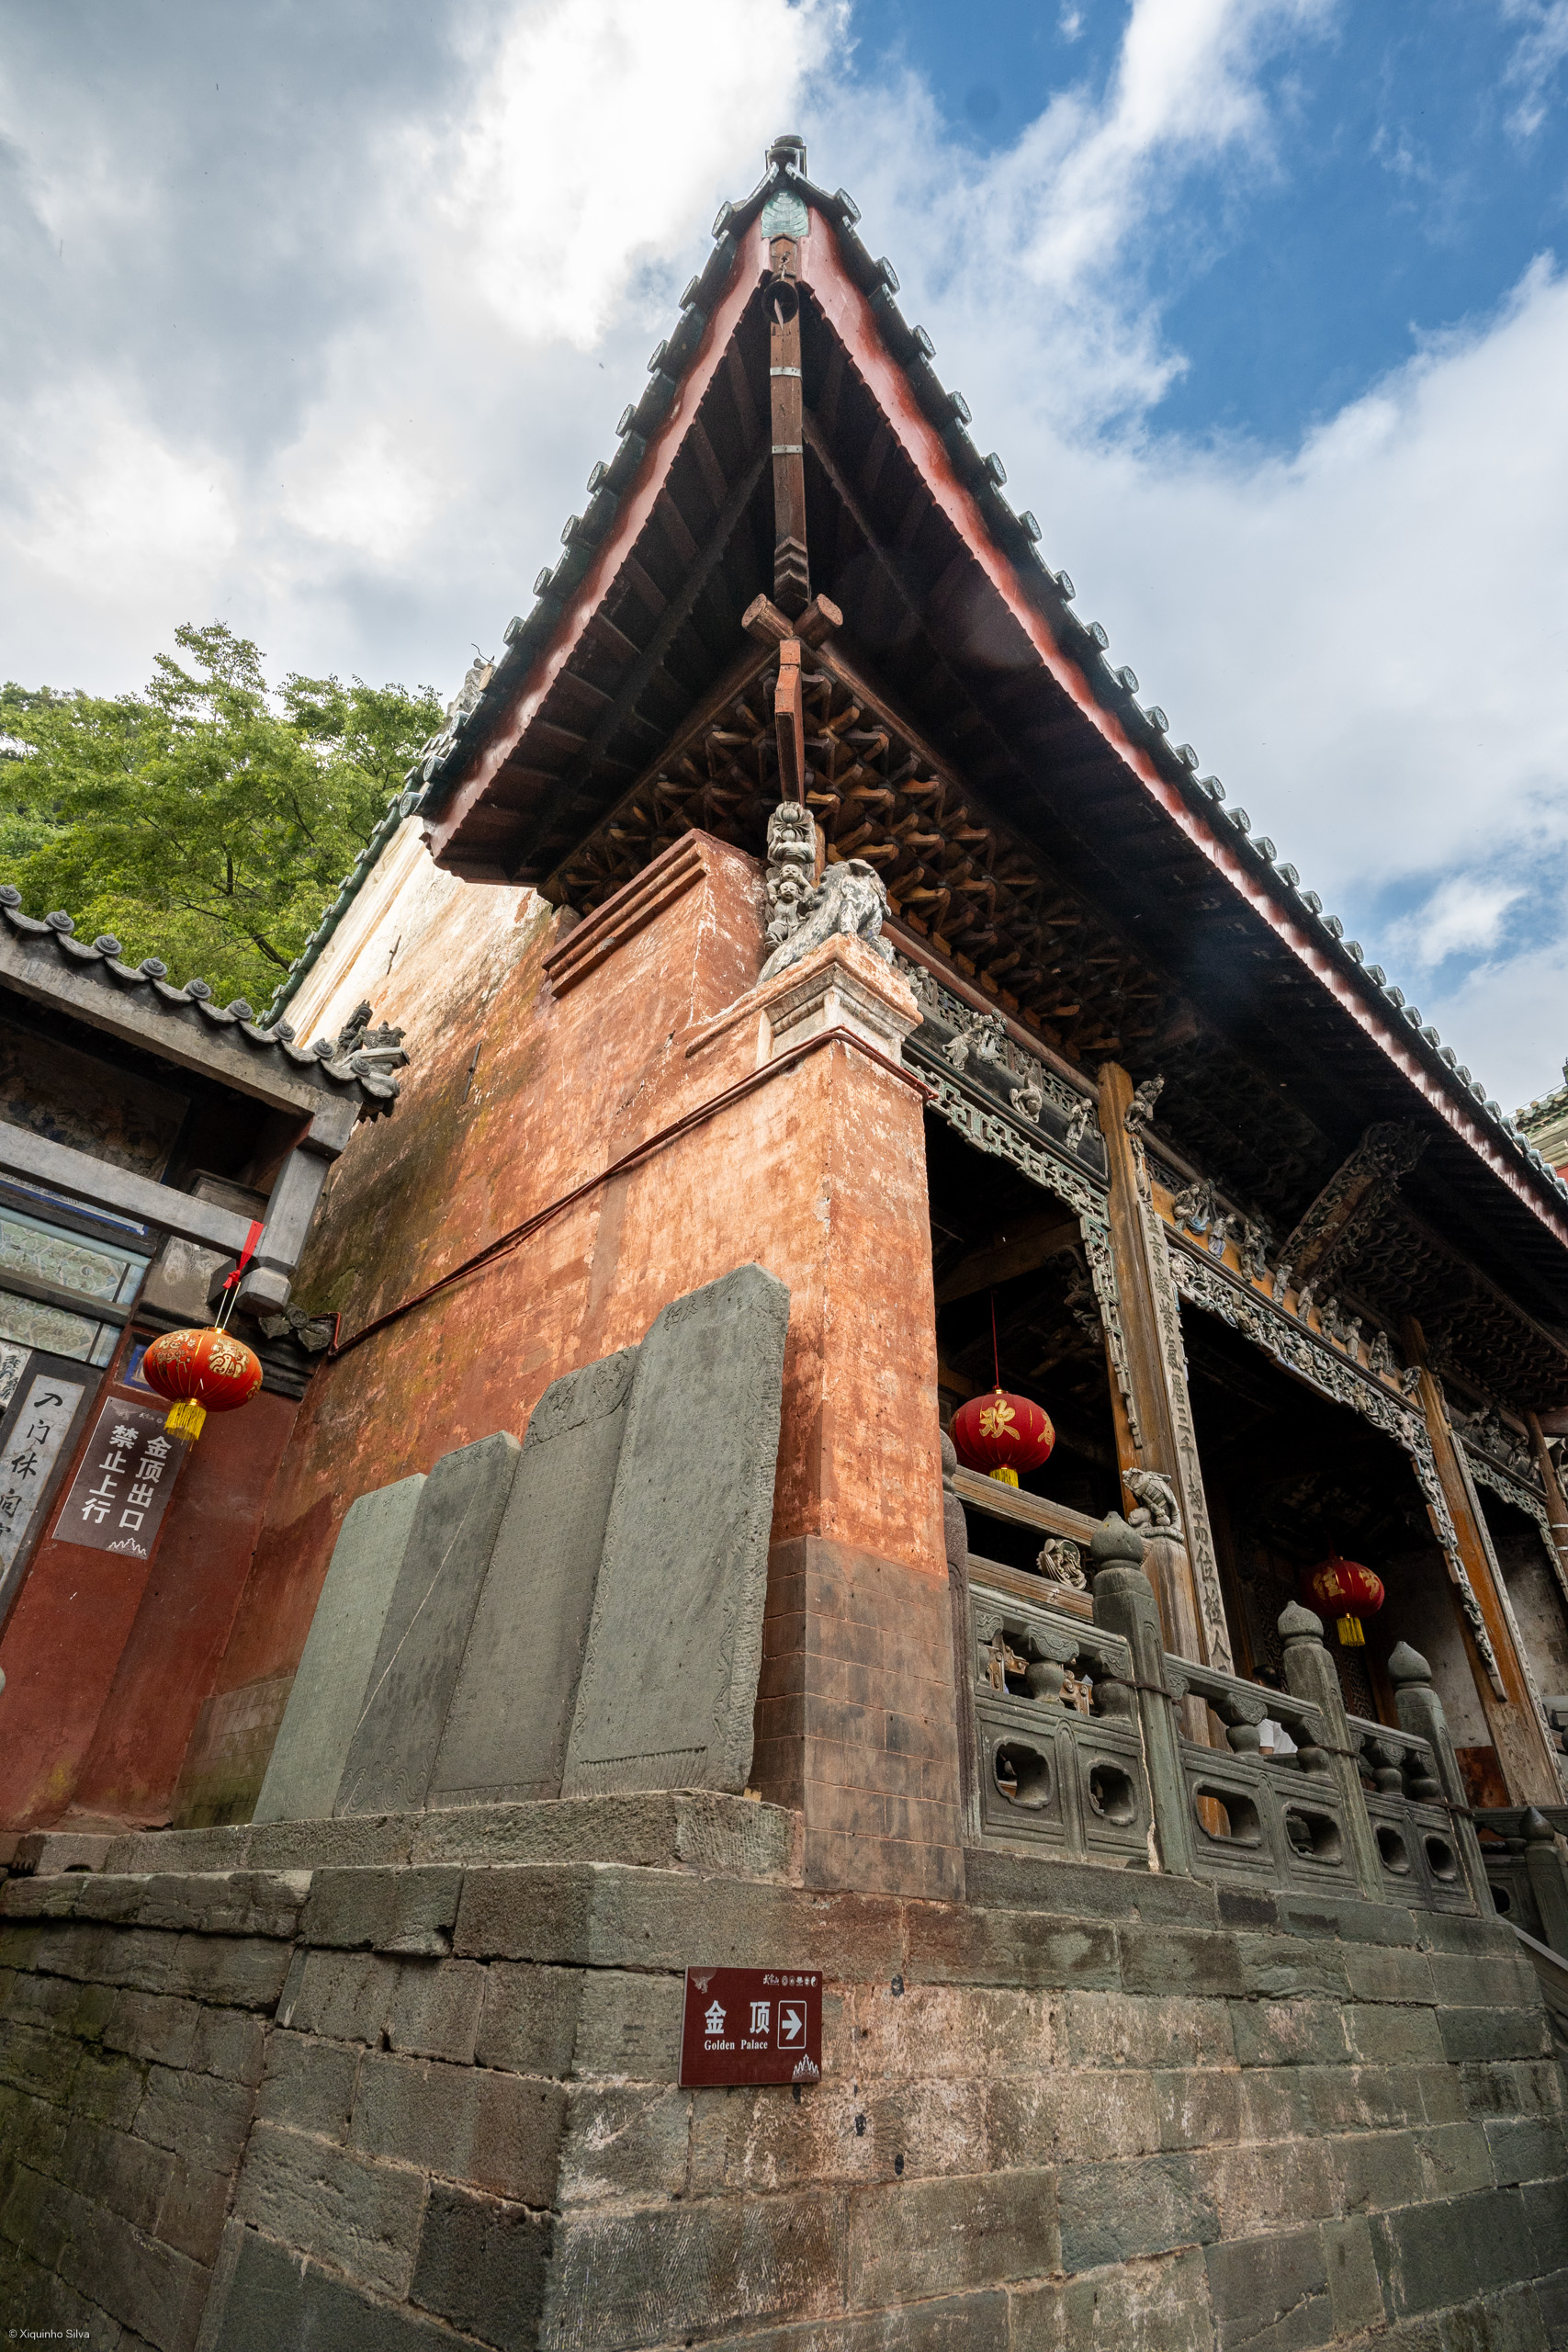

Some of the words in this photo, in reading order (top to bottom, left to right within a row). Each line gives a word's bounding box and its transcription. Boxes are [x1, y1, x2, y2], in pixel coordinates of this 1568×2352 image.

[0, 1392, 63, 1534] 入门休问
[82, 1425, 139, 1524] 禁止上行
[119, 1435, 172, 1531] 金顶出口
[705, 2000, 771, 2034] 金顶
[705, 2040, 735, 2050] Golden
[740, 2040, 768, 2050] Palace
